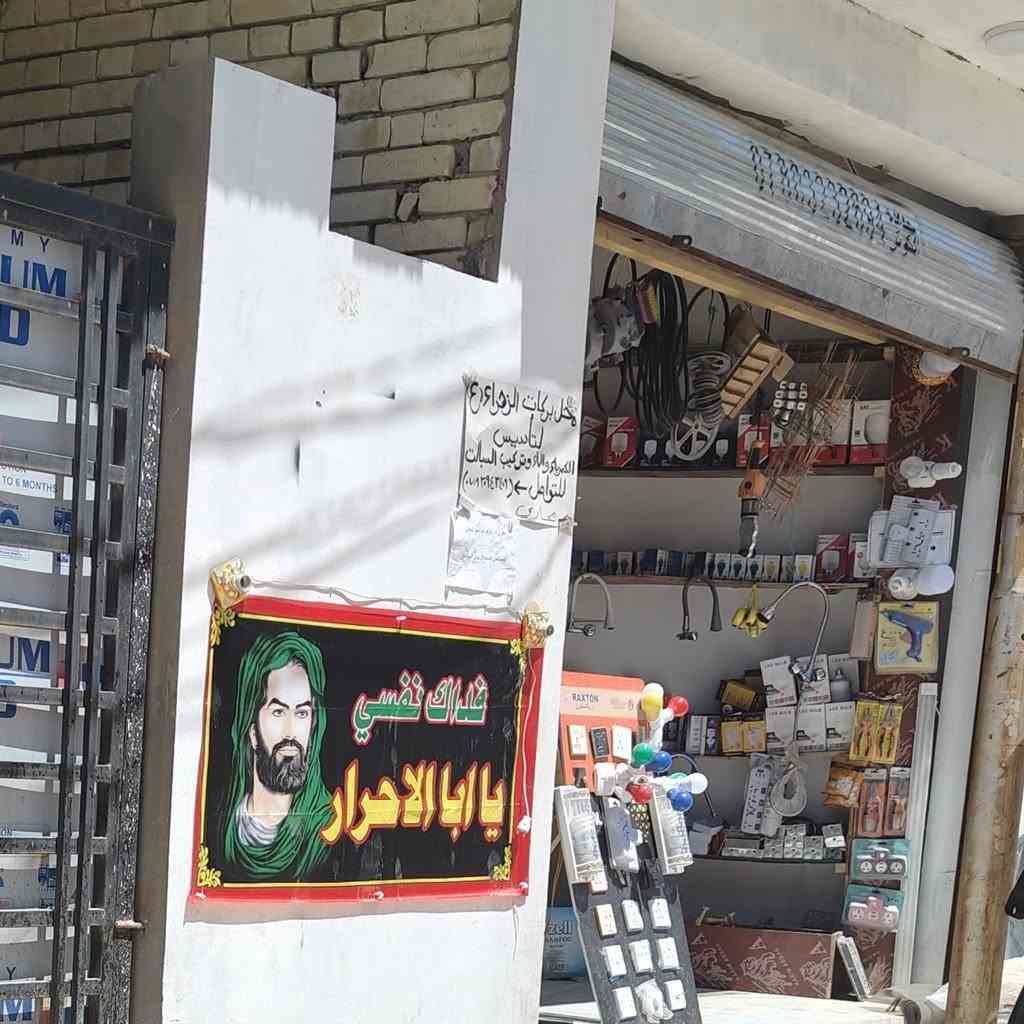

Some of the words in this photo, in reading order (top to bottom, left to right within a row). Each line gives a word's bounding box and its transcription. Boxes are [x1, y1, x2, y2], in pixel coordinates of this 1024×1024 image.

[2, 475, 14, 487] TO
[22, 478, 58, 494] MONTHS
[351, 668, 424, 744] نفسي
[426, 673, 490, 726] فداك
[320, 758, 438, 845] الاحرار
[478, 761, 507, 842] يا
